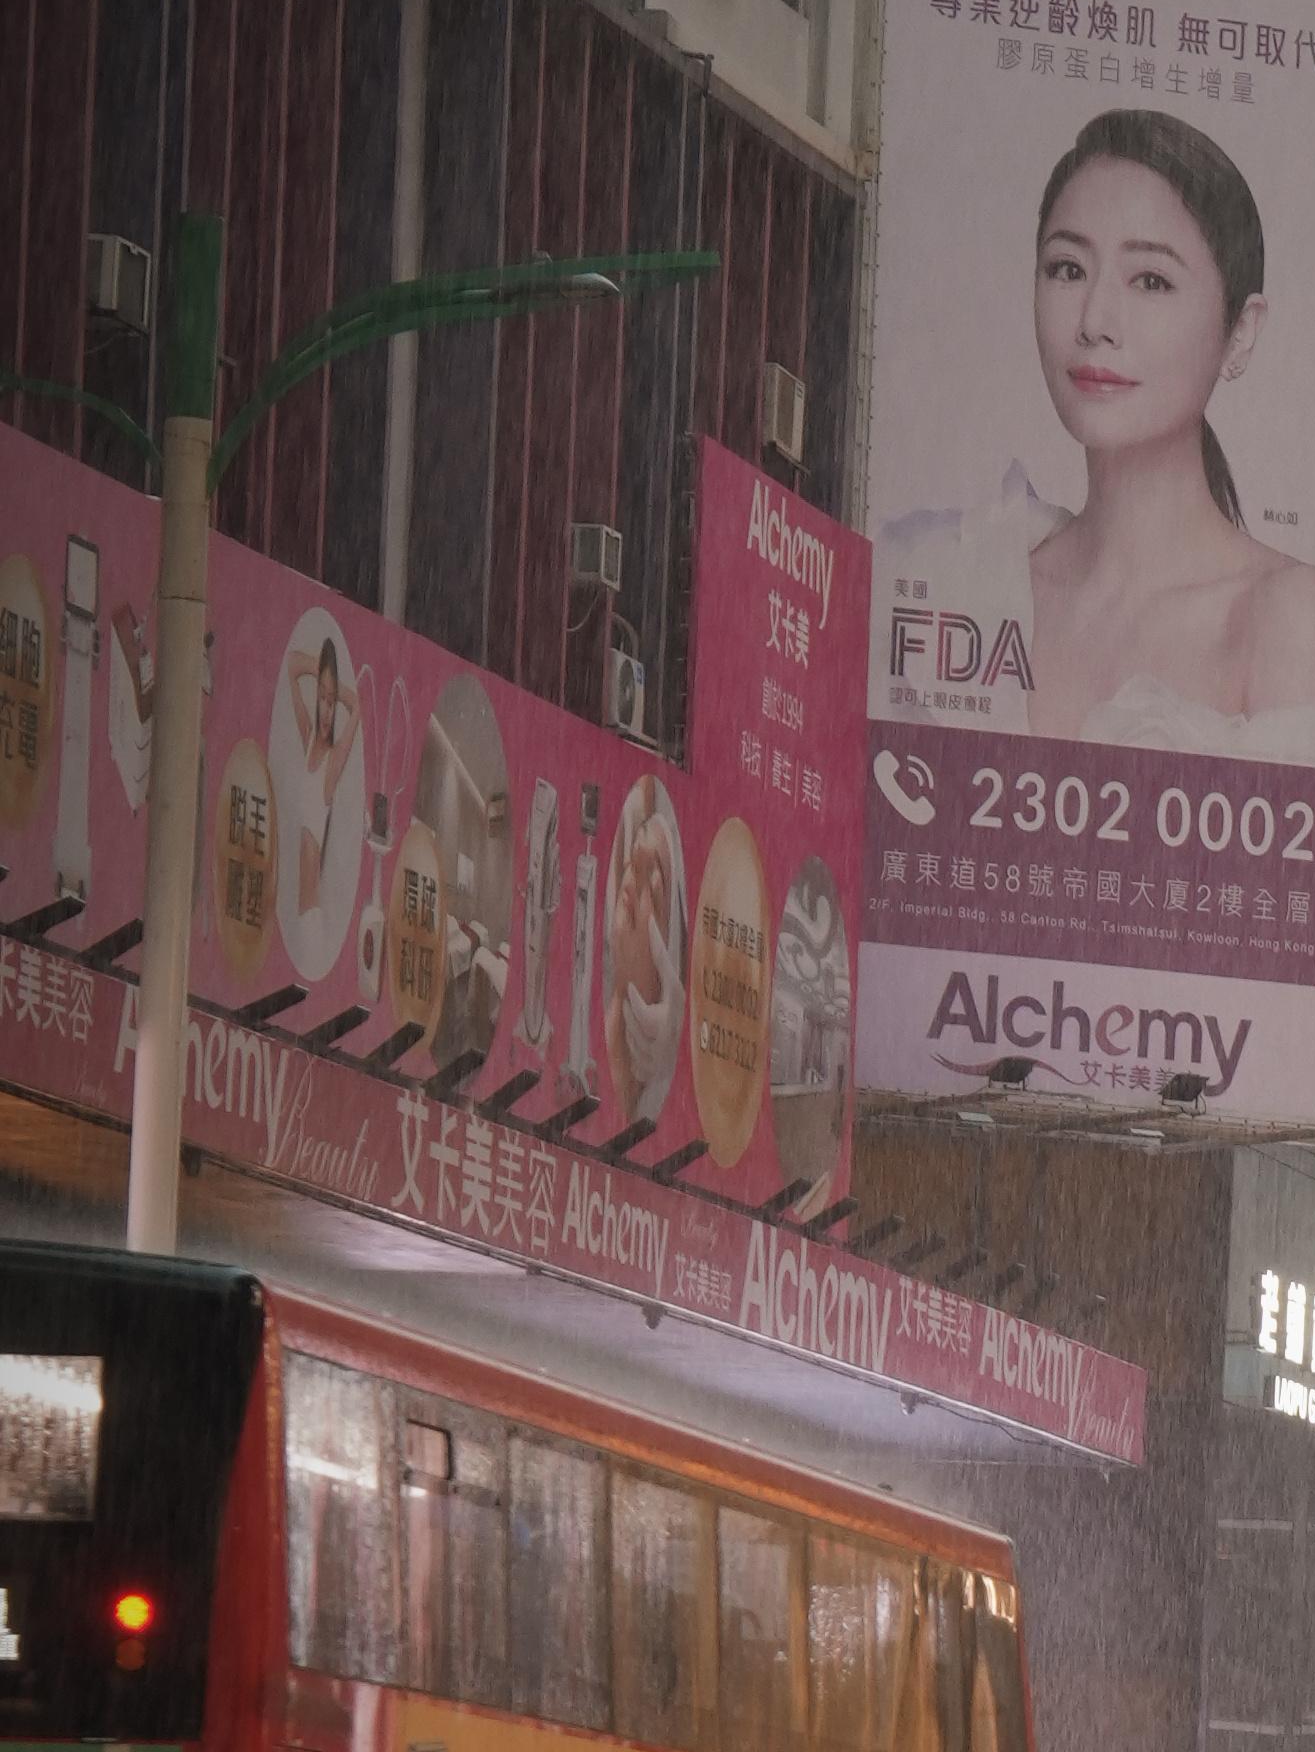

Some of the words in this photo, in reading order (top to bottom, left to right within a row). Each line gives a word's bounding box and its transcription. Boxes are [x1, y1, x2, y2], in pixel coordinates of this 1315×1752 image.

[996, 36, 1257, 105] 膠原蛋白增生增量
[747, 478, 834, 630] Alchemy
[893, 578, 928, 599] 美國
[765, 588, 809, 670] 艾卡美
[890, 607, 1035, 691] FDA
[969, 767, 1131, 842] 2302
[1156, 786, 1315, 862] 0002
[880, 848, 1312, 925] 廣東道58號帝國大廈2樓全層
[900, 901, 953, 917] Imperial
[1000, 911, 1016, 924] 58
[1021, 913, 1065, 928] Canton
[1249, 937, 1280, 953] Hong
[1285, 941, 1315, 957] Kong
[113, 982, 289, 1168] Ahemy
[926, 970, 1253, 1098] Alchemy
[391, 1088, 558, 1255] 艾卡美美容
[560, 1161, 669, 1299] Alchemy
[672, 1251, 732, 1312] 艾卡美美容
[740, 1220, 892, 1374] Alchemy
[895, 1273, 973, 1358] 艾卡美美容
[980, 1307, 1085, 1439] Alchemy
